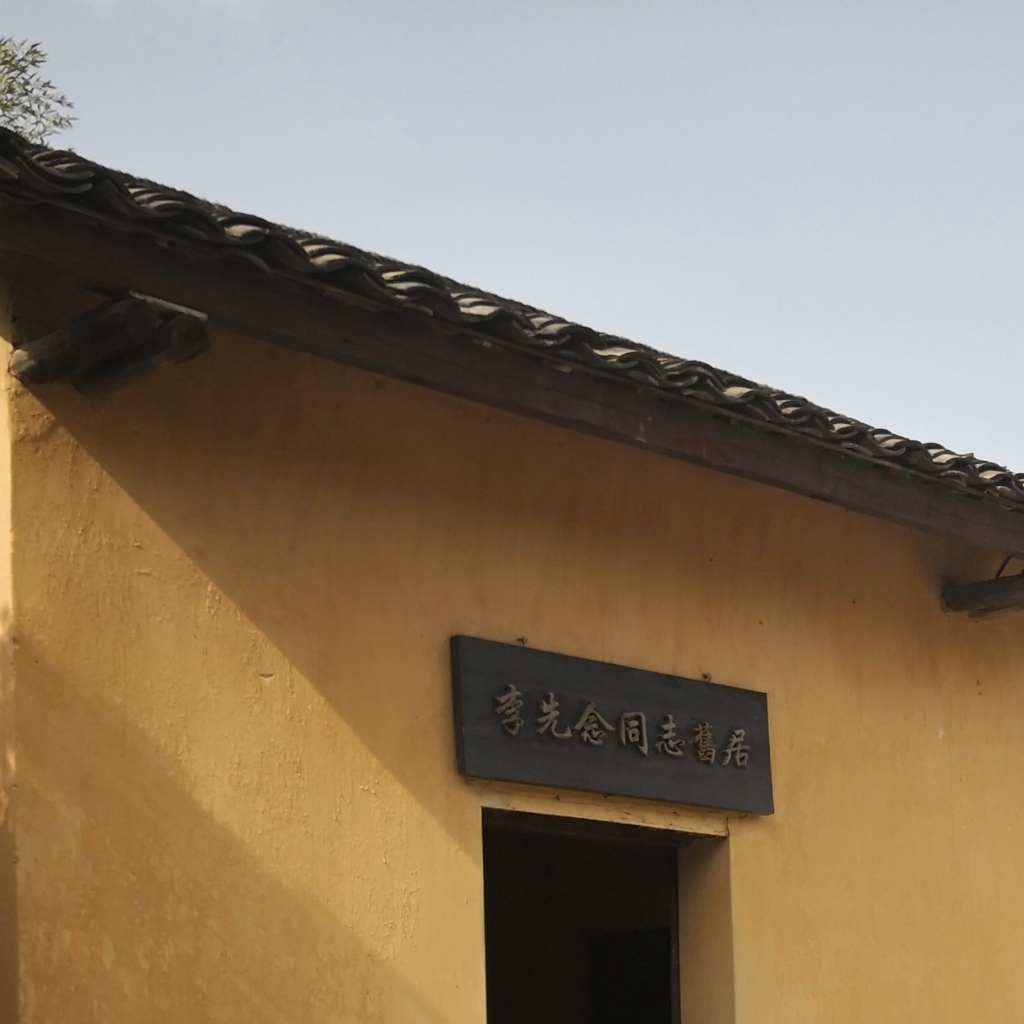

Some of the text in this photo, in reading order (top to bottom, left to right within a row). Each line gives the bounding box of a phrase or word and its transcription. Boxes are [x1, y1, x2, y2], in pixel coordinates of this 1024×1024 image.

[495, 683, 750, 767] 李先念同志舊居
